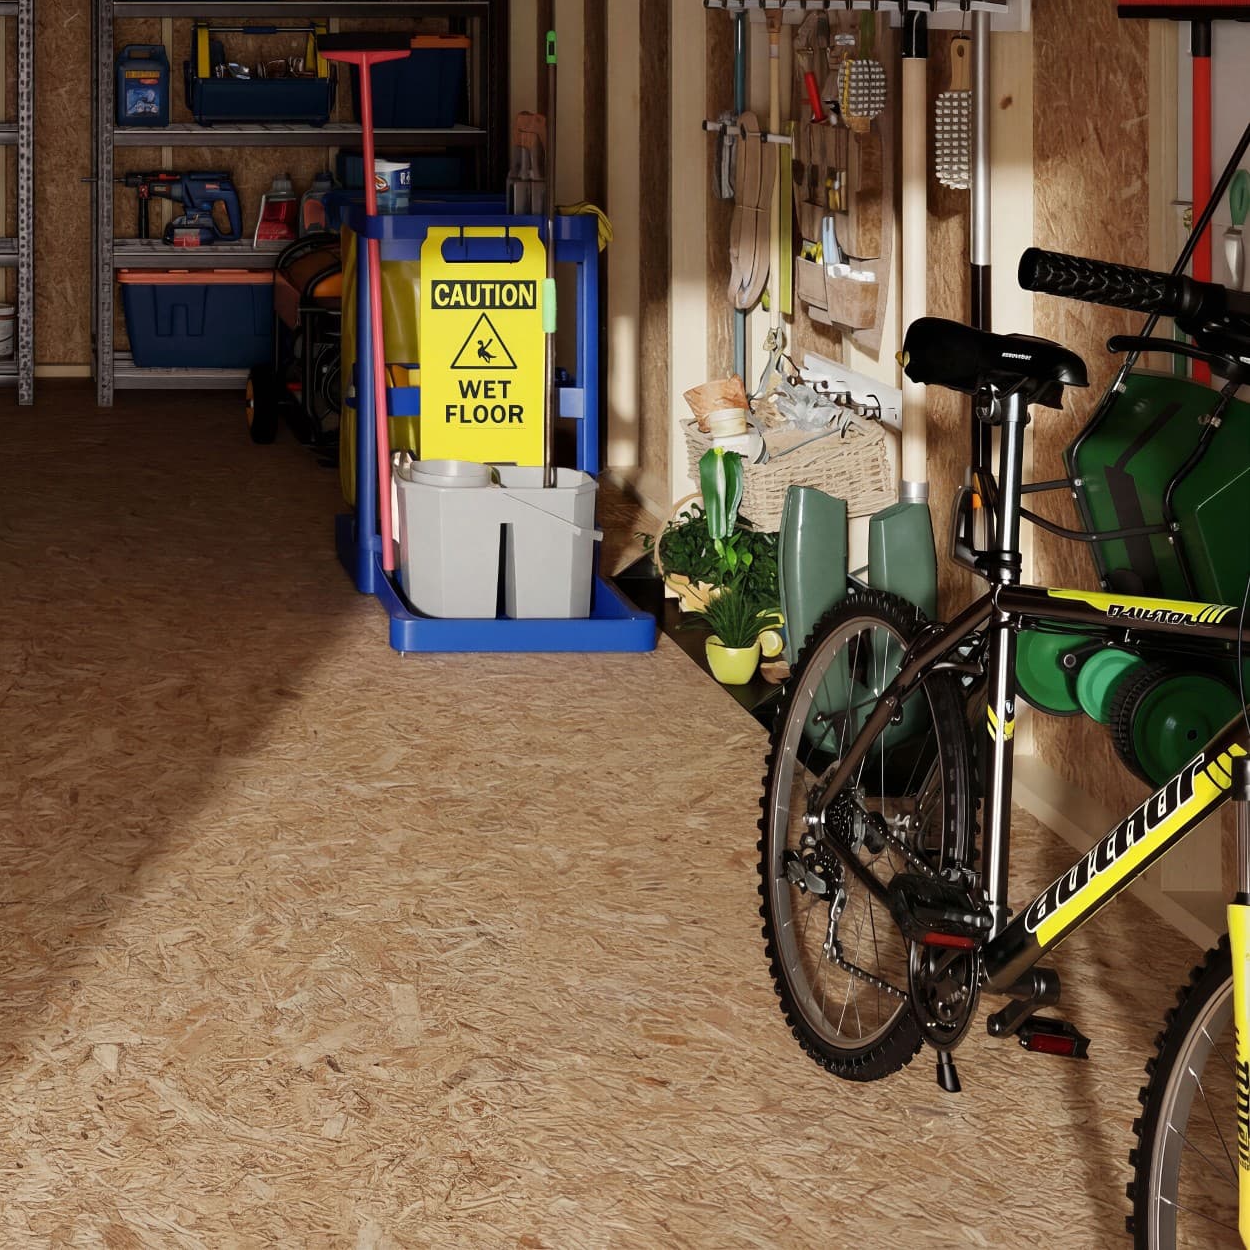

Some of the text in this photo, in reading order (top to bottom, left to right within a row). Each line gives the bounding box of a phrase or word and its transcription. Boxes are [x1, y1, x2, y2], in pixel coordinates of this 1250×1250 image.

[434, 283, 534, 307] CAUTION
[458, 380, 512, 399] WET
[445, 404, 524, 424] FLOOR
